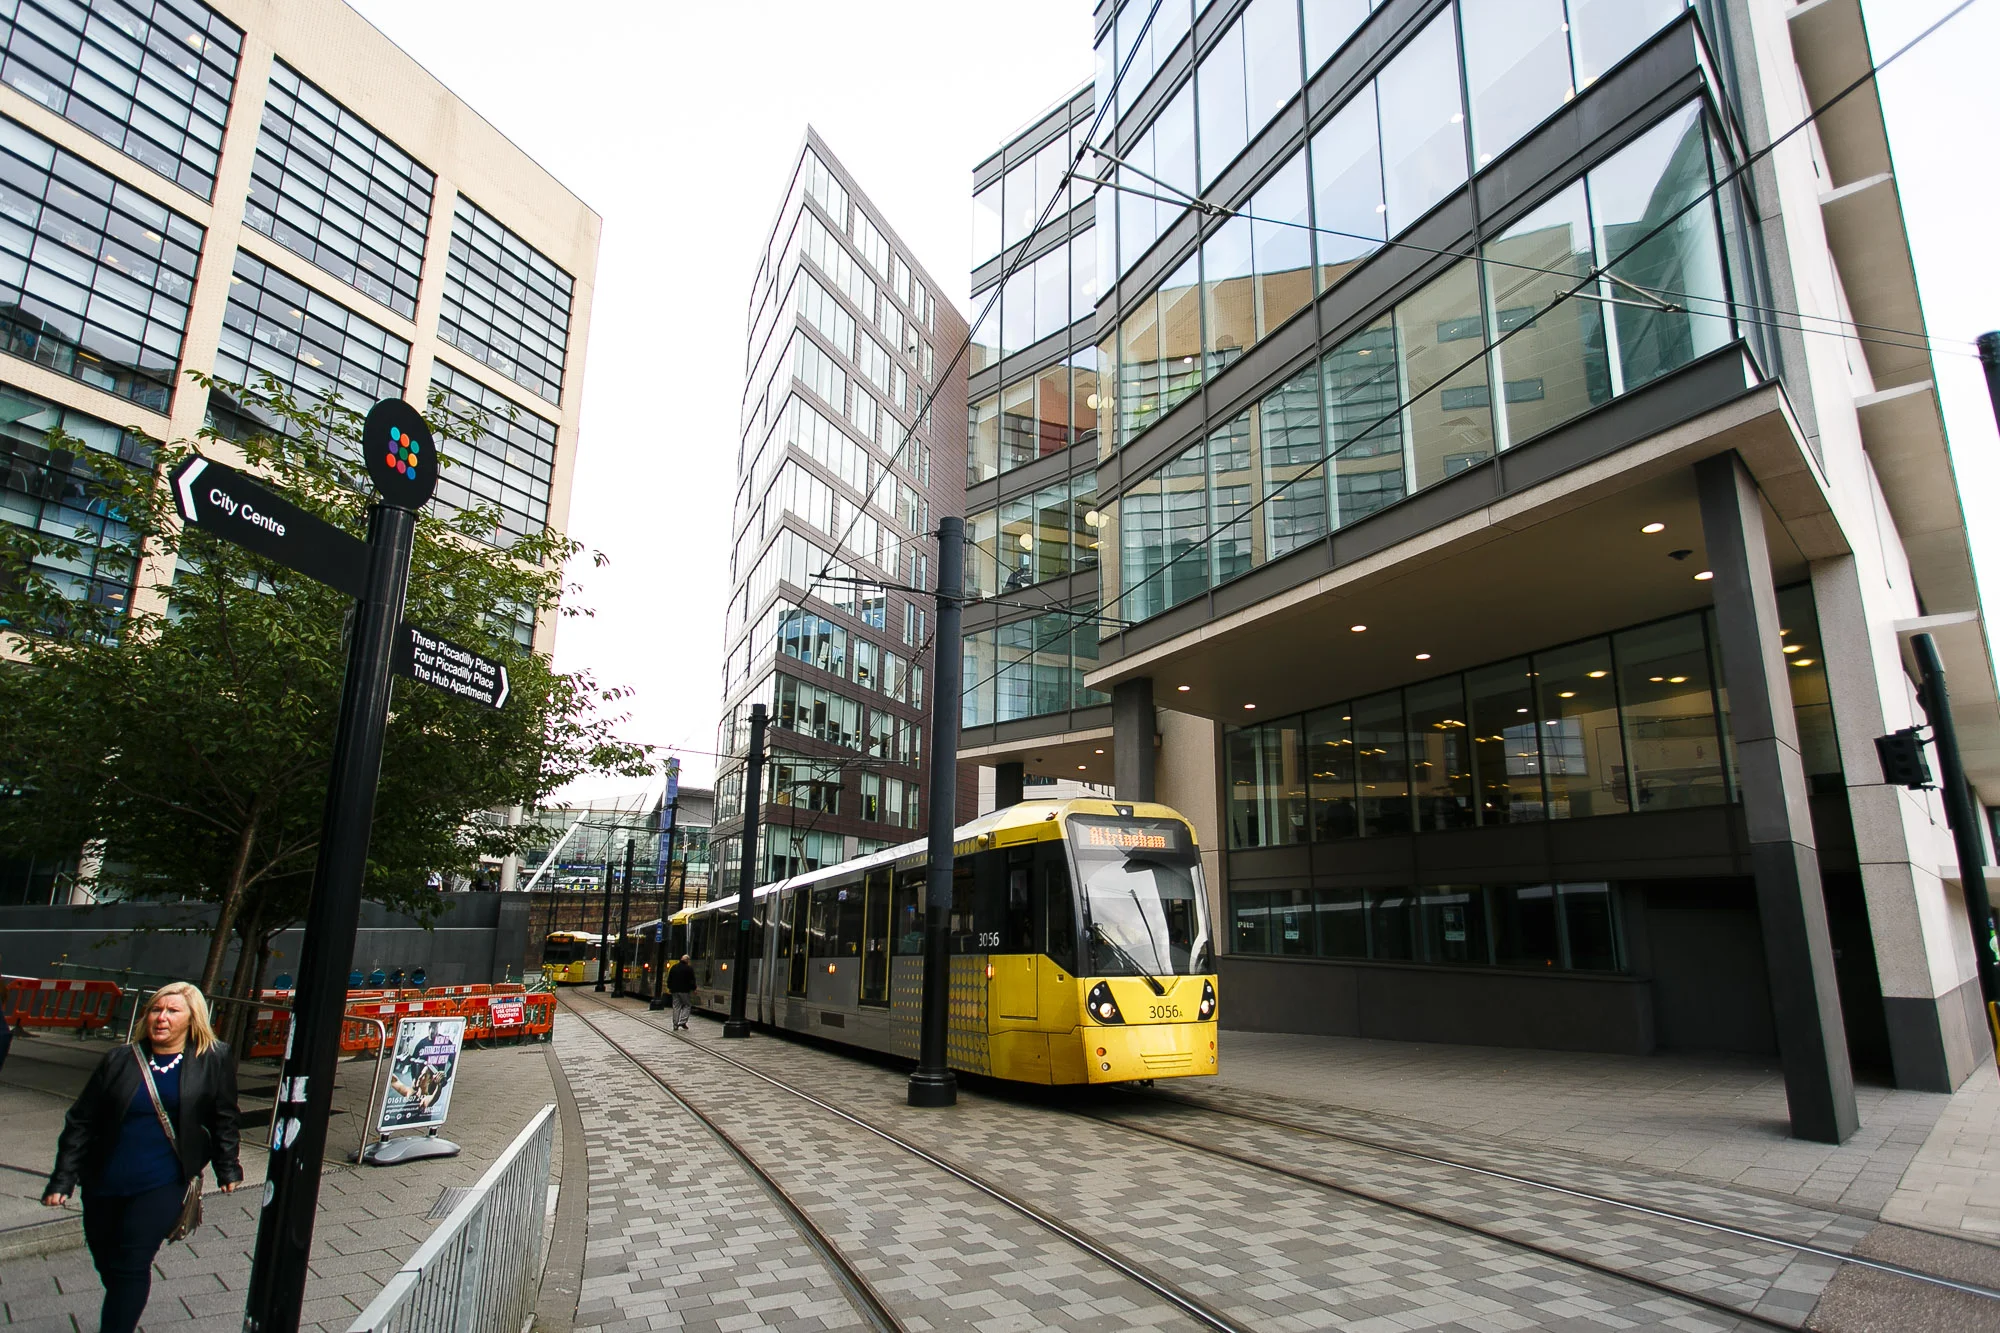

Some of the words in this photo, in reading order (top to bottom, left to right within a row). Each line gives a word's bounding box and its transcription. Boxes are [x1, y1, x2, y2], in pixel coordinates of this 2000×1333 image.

[210, 488, 238, 516] City
[241, 504, 286, 536] Centre
[411, 629, 437, 650] Three
[437, 641, 474, 669] Piccadilly
[475, 657, 496, 676] Place
[413, 647, 435, 666] Four
[435, 656, 473, 683] Piccadilly
[473, 672, 494, 689] Place
[413, 663, 430, 681] The
[431, 671, 449, 688] Hub
[449, 678, 492, 704] Apartments
[1089, 826, 1166, 848] Altrincham
[979, 932, 1000, 947] 3056
[387, 1096, 402, 1104] 0161
